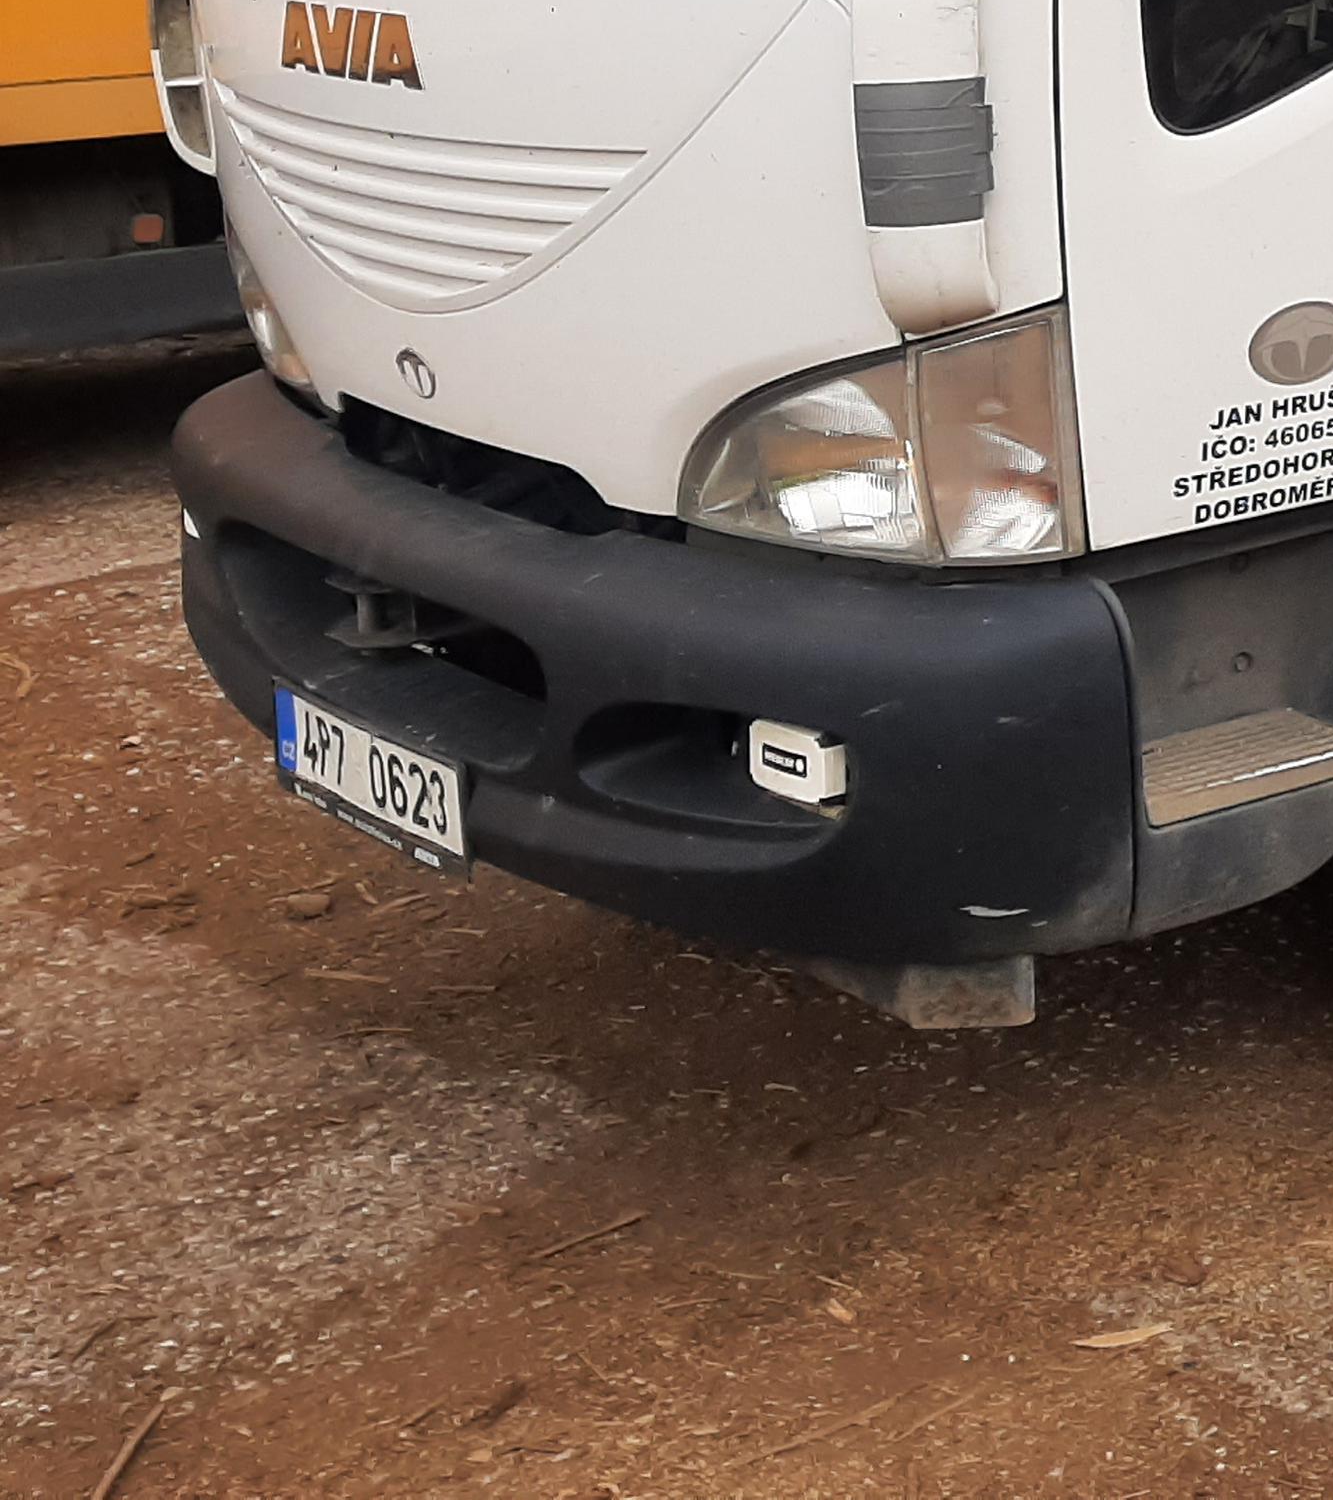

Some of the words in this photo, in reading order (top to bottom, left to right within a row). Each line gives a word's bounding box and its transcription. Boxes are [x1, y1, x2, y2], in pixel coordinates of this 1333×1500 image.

[281, 1, 425, 90] AVIA
[1210, 403, 1262, 430] JAN
[1201, 435, 1256, 462] IČO:
[304, 711, 344, 785] 4P7
[369, 745, 447, 835] 0623
